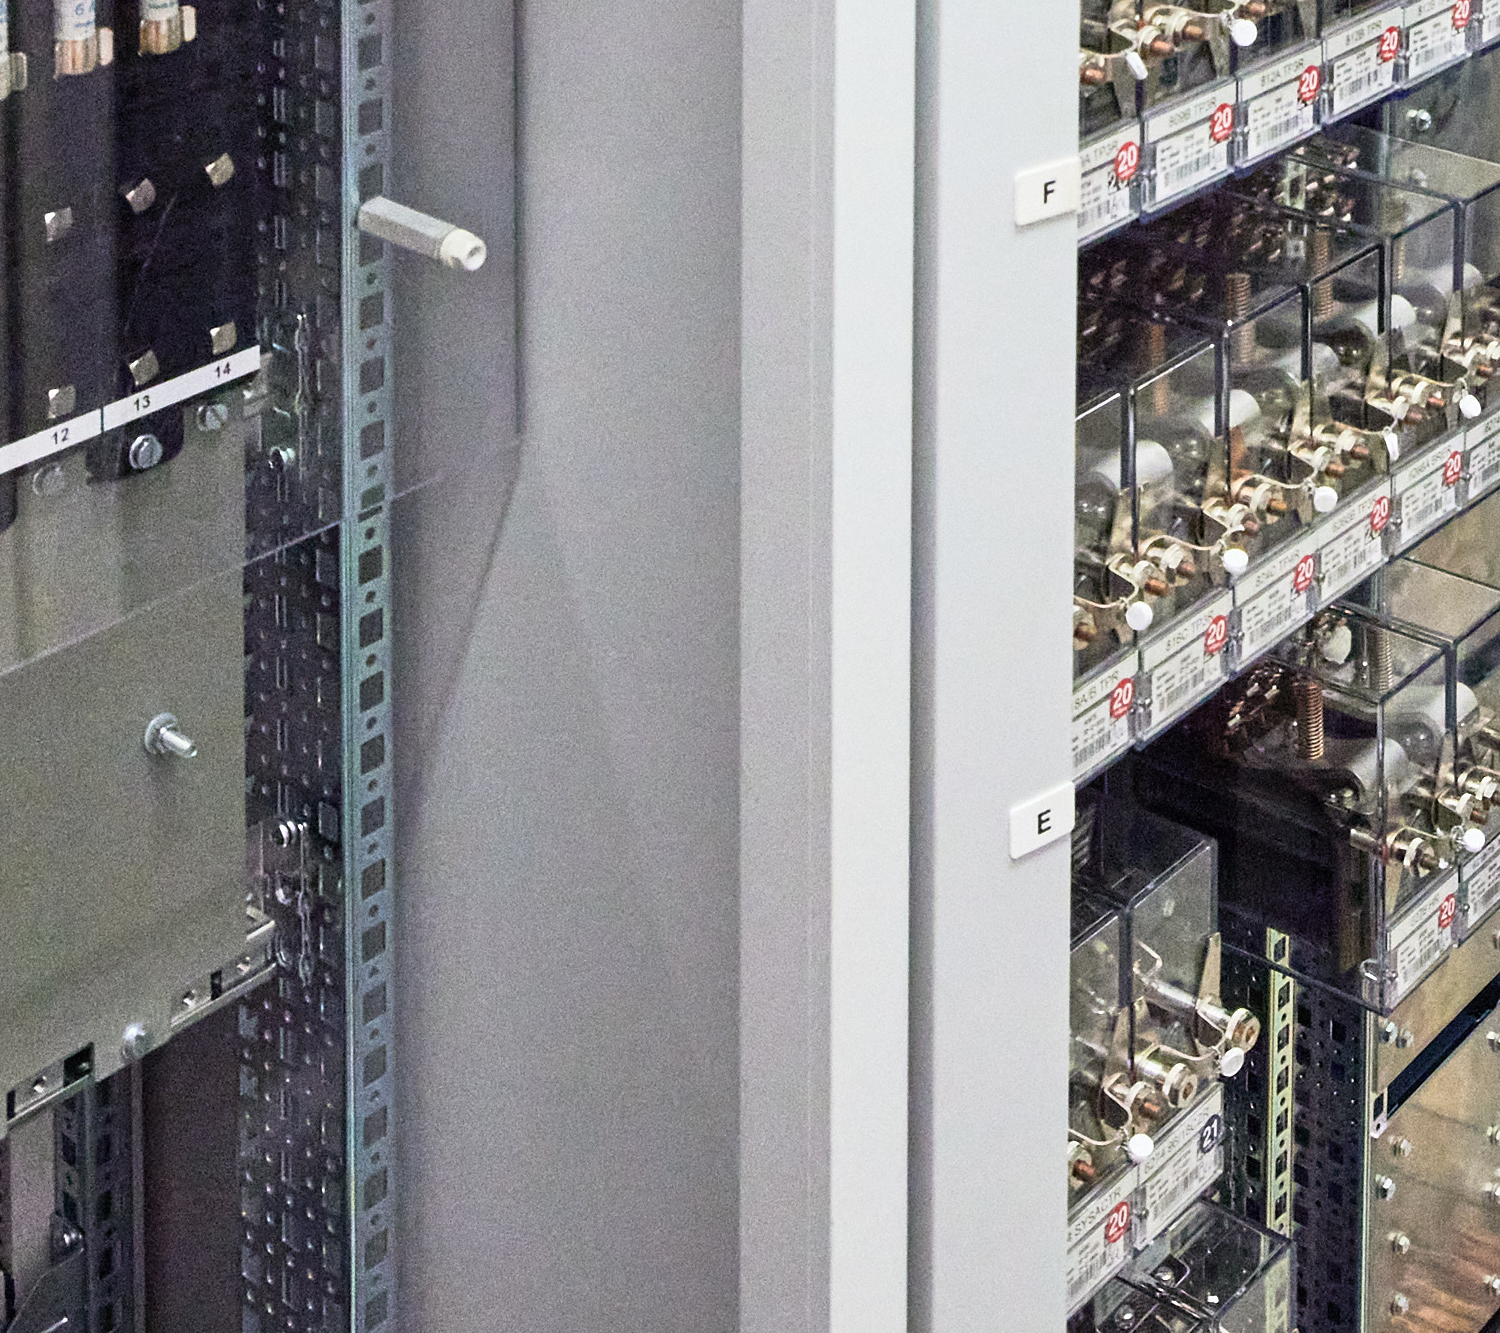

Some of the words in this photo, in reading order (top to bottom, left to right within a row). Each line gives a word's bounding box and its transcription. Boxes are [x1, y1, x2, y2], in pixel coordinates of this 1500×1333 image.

[1453, 1, 1470, 22] 20
[1381, 32, 1398, 55] 20
[1300, 71, 1319, 94] 20
[1213, 109, 1232, 133] 20
[1117, 148, 1138, 172] 20
[1043, 179, 1057, 205] F
[51, 426, 70, 445] 12
[133, 393, 151, 411] 13
[213, 361, 232, 379] 14
[1445, 456, 1461, 479] 20
[1372, 502, 1389, 525] 20
[1297, 561, 1314, 584] 20
[1207, 621, 1226, 645] 20
[1112, 684, 1134, 710] 20
[1037, 809, 1053, 835] E
[1439, 899, 1455, 921] 20
[1203, 1120, 1221, 1146] 21
[1109, 1209, 1128, 1236] 20
